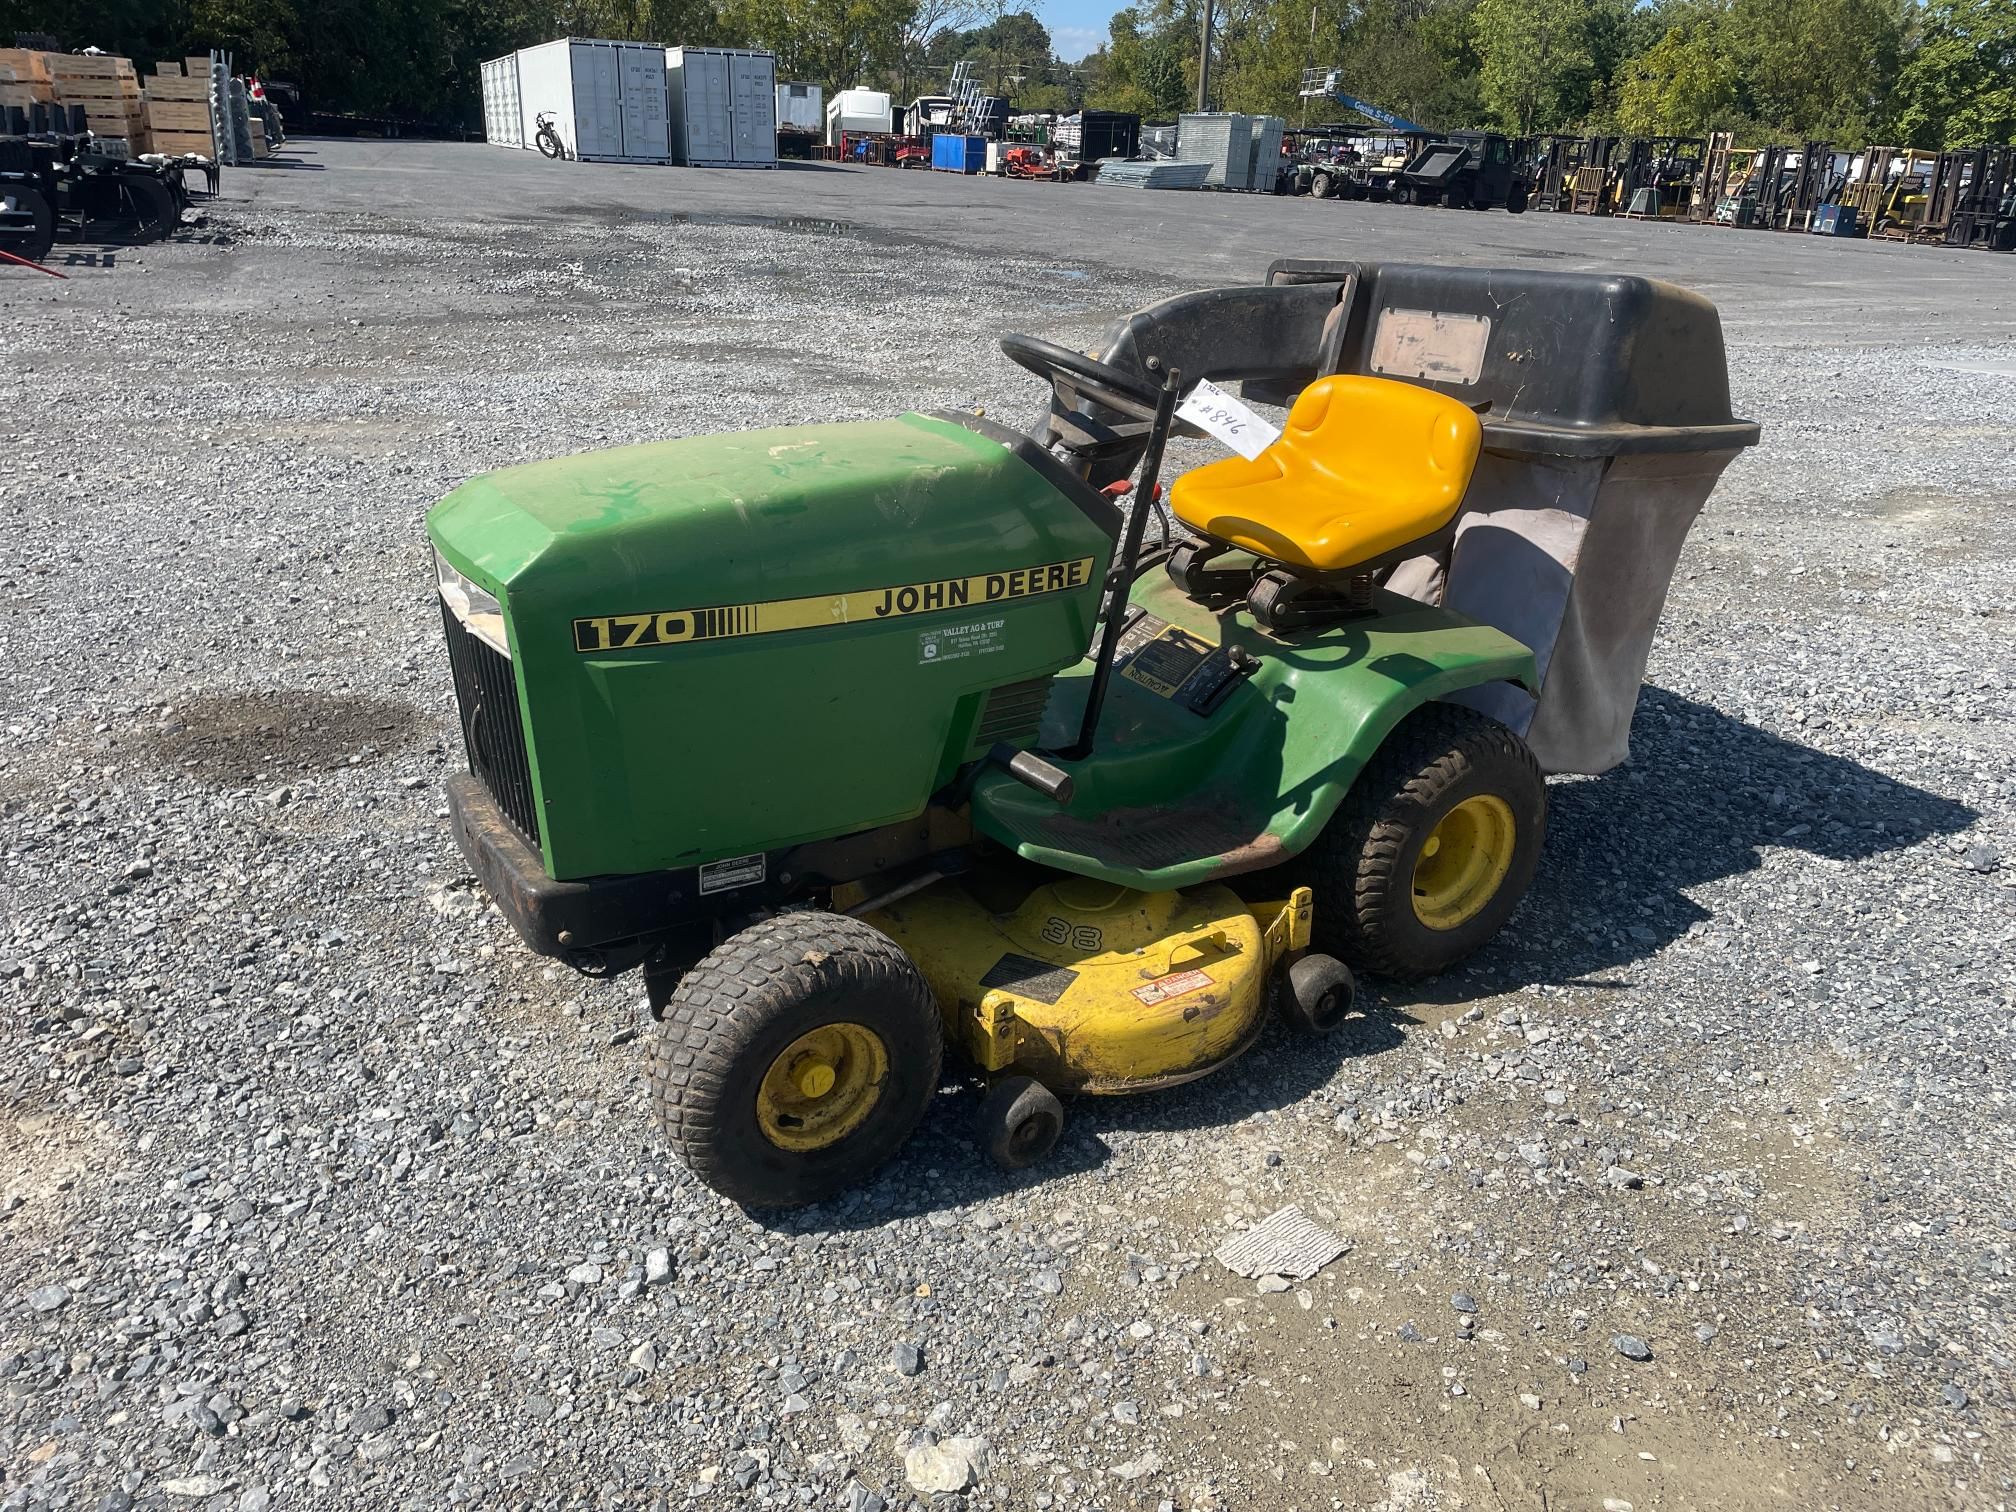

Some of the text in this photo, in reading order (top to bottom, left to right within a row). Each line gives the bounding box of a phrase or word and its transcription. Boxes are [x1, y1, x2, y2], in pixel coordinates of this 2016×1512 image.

[1354, 101, 1395, 124] Genie S-60
[1199, 405, 1247, 435] #846
[589, 559, 1084, 649] 170 JOHN DEERE
[943, 625, 970, 637] VALLEY
[970, 624, 980, 633] AG
[987, 620, 1005, 630] TURF
[1128, 670, 1161, 691] CAUTION
[1042, 916, 1102, 952] 38
